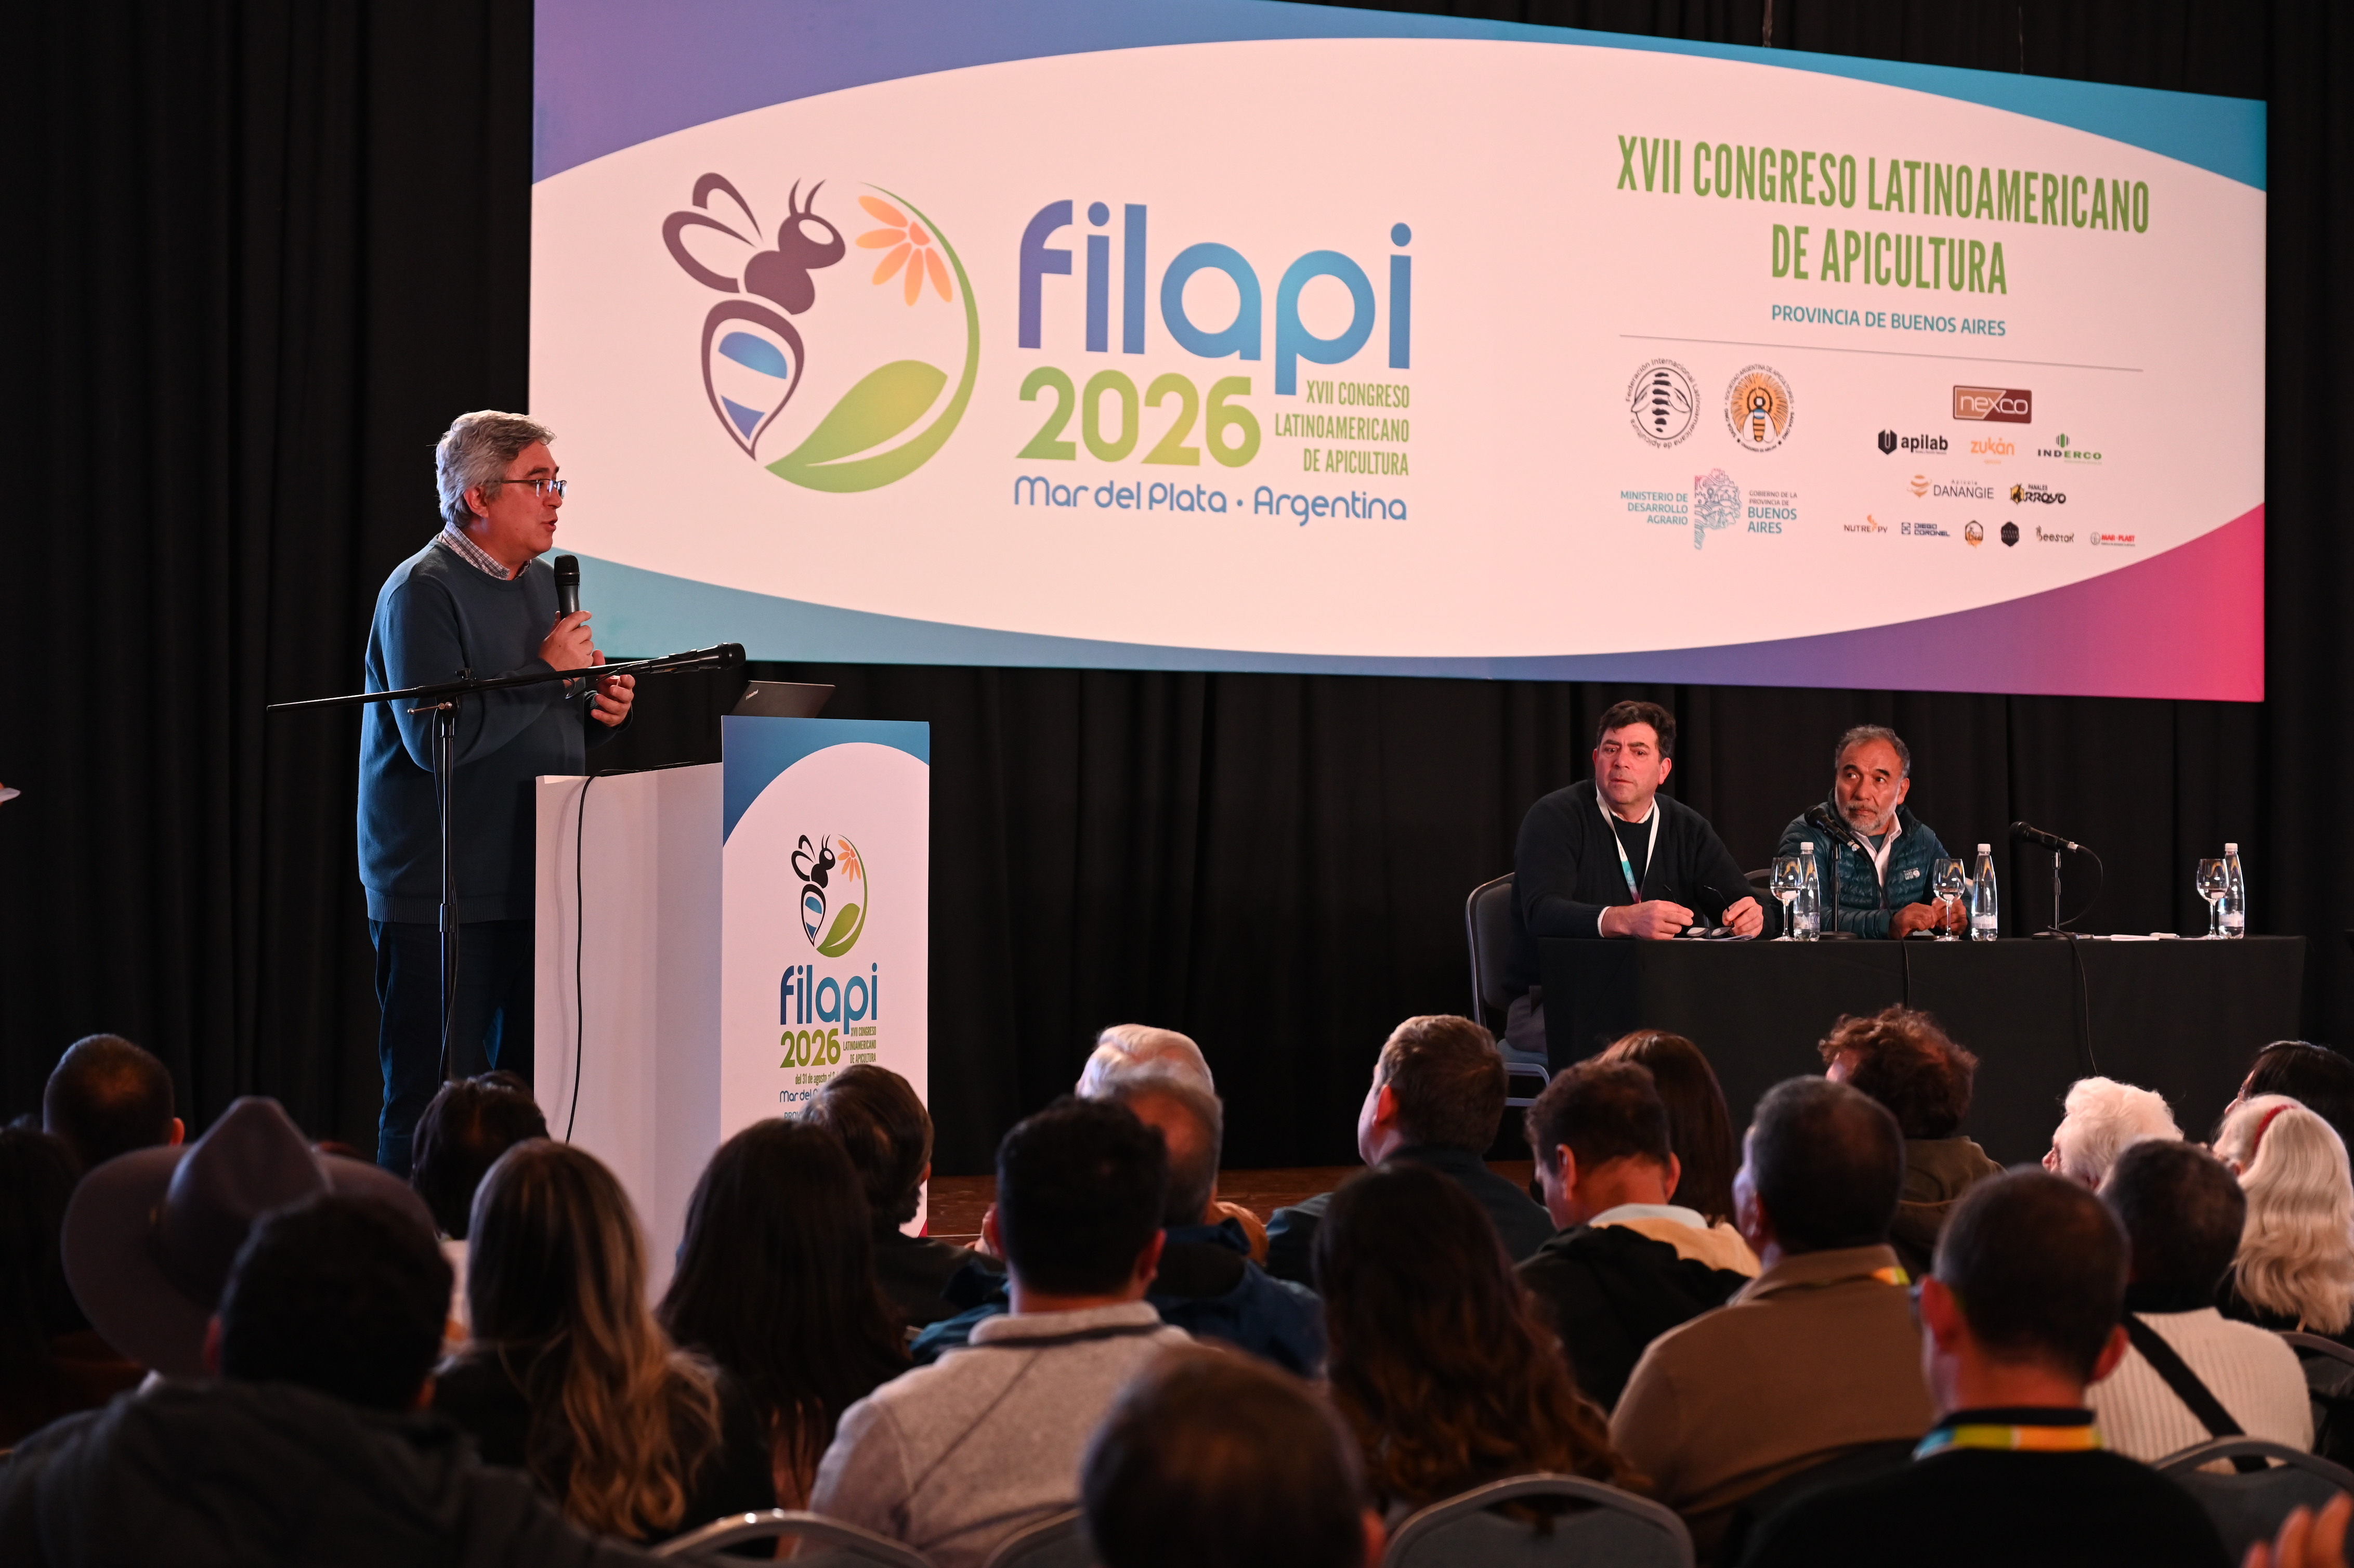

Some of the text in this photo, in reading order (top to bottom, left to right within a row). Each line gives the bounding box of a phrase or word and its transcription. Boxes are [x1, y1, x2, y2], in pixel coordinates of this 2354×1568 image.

[1617, 134, 2149, 233] XVII CONGRESO LATINOAMERICANO
[1772, 224, 2007, 295] DE APICULTURA
[1018, 199, 1412, 396] filapi
[1772, 304, 2007, 337] PROVINCIA DE BUENOS AIRES
[1306, 380, 1410, 409] XVII CONGRESO
[1015, 366, 1261, 468] 2026
[1275, 413, 1410, 443] LATINOAMERICANO
[1901, 434, 1948, 453] apilab
[2038, 449, 2102, 459] INDERCO
[1303, 449, 1409, 476] DE APICULTURA
[1621, 491, 1689, 502] MINISTERIO DE
[1933, 485, 1995, 499] DANANGIE
[1015, 475, 1407, 527] Mar del Plata Argentina
[1628, 503, 1688, 514] DESARROLLO
[1647, 515, 1688, 525] AGRARIO
[1748, 507, 1797, 520] BUENOS
[1748, 522, 1782, 533] AIRES
[780, 962, 878, 1035] filapi
[858, 1026, 877, 1037] CONGRESO
[780, 1028, 841, 1068] 2026
[843, 1040, 877, 1051] LATINOAMERICANO
[850, 1053, 877, 1064] DE APICULTURA
[802, 1073, 807, 1084] 31
[807, 1073, 813, 1084] de
[780, 1090, 799, 1103] Mar
